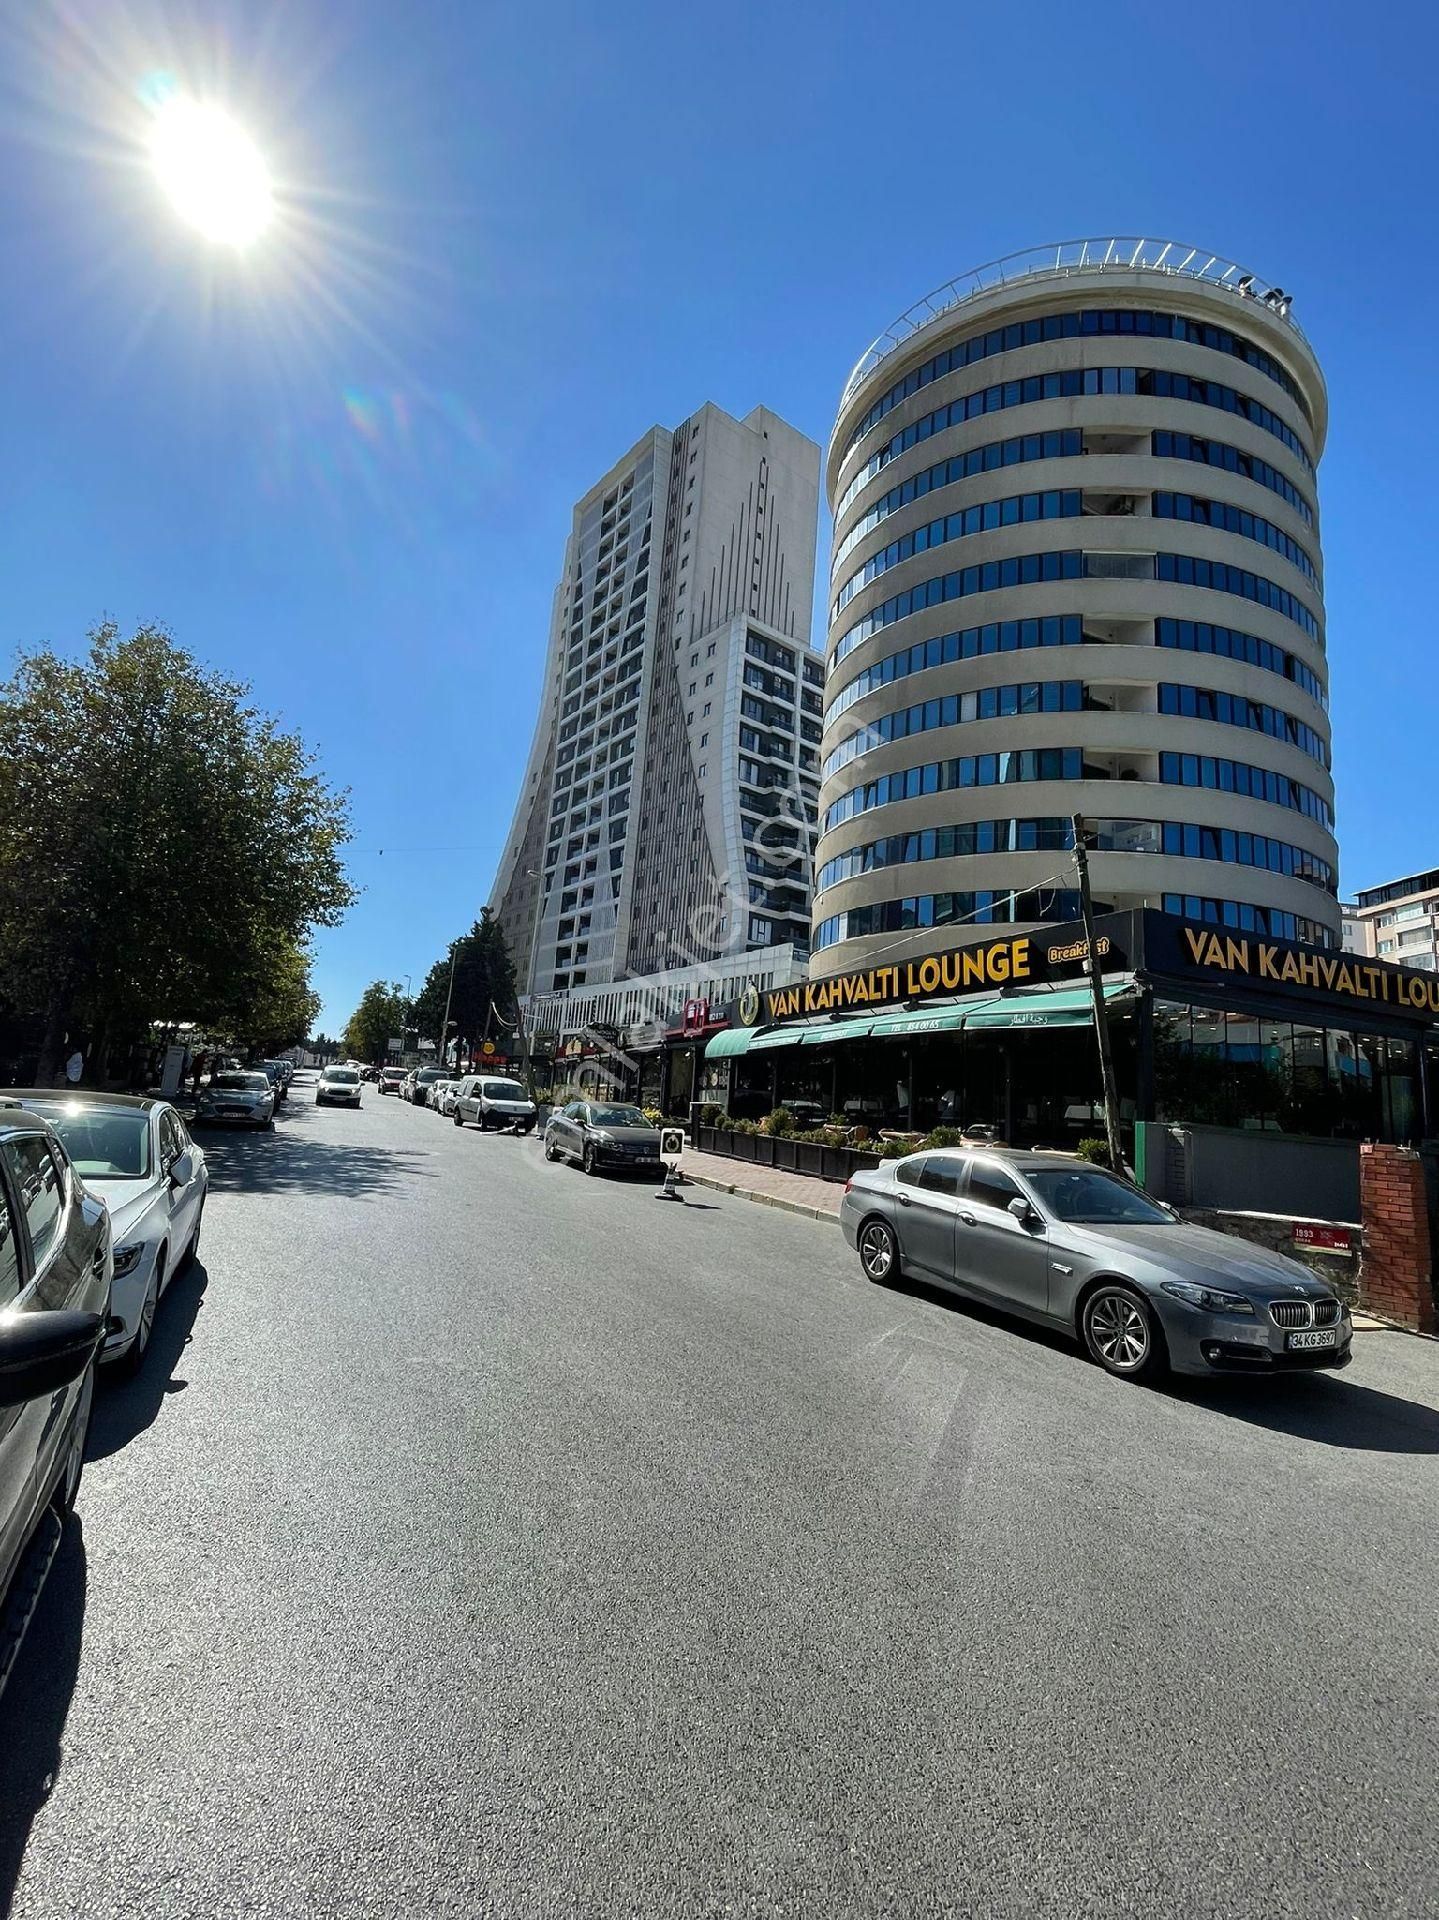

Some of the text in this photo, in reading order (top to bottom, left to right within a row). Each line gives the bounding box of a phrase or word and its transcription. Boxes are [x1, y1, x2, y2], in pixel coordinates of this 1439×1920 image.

[1049, 938, 1108, 962] Breakfst
[1185, 928, 1250, 974] VAN
[1258, 943, 1388, 1001] KAHVALTI
[768, 938, 1031, 1018] VAN KAHVALTI LOUNGE
[1294, 1334, 1303, 1346] 34
[1304, 1333, 1316, 1346] KG
